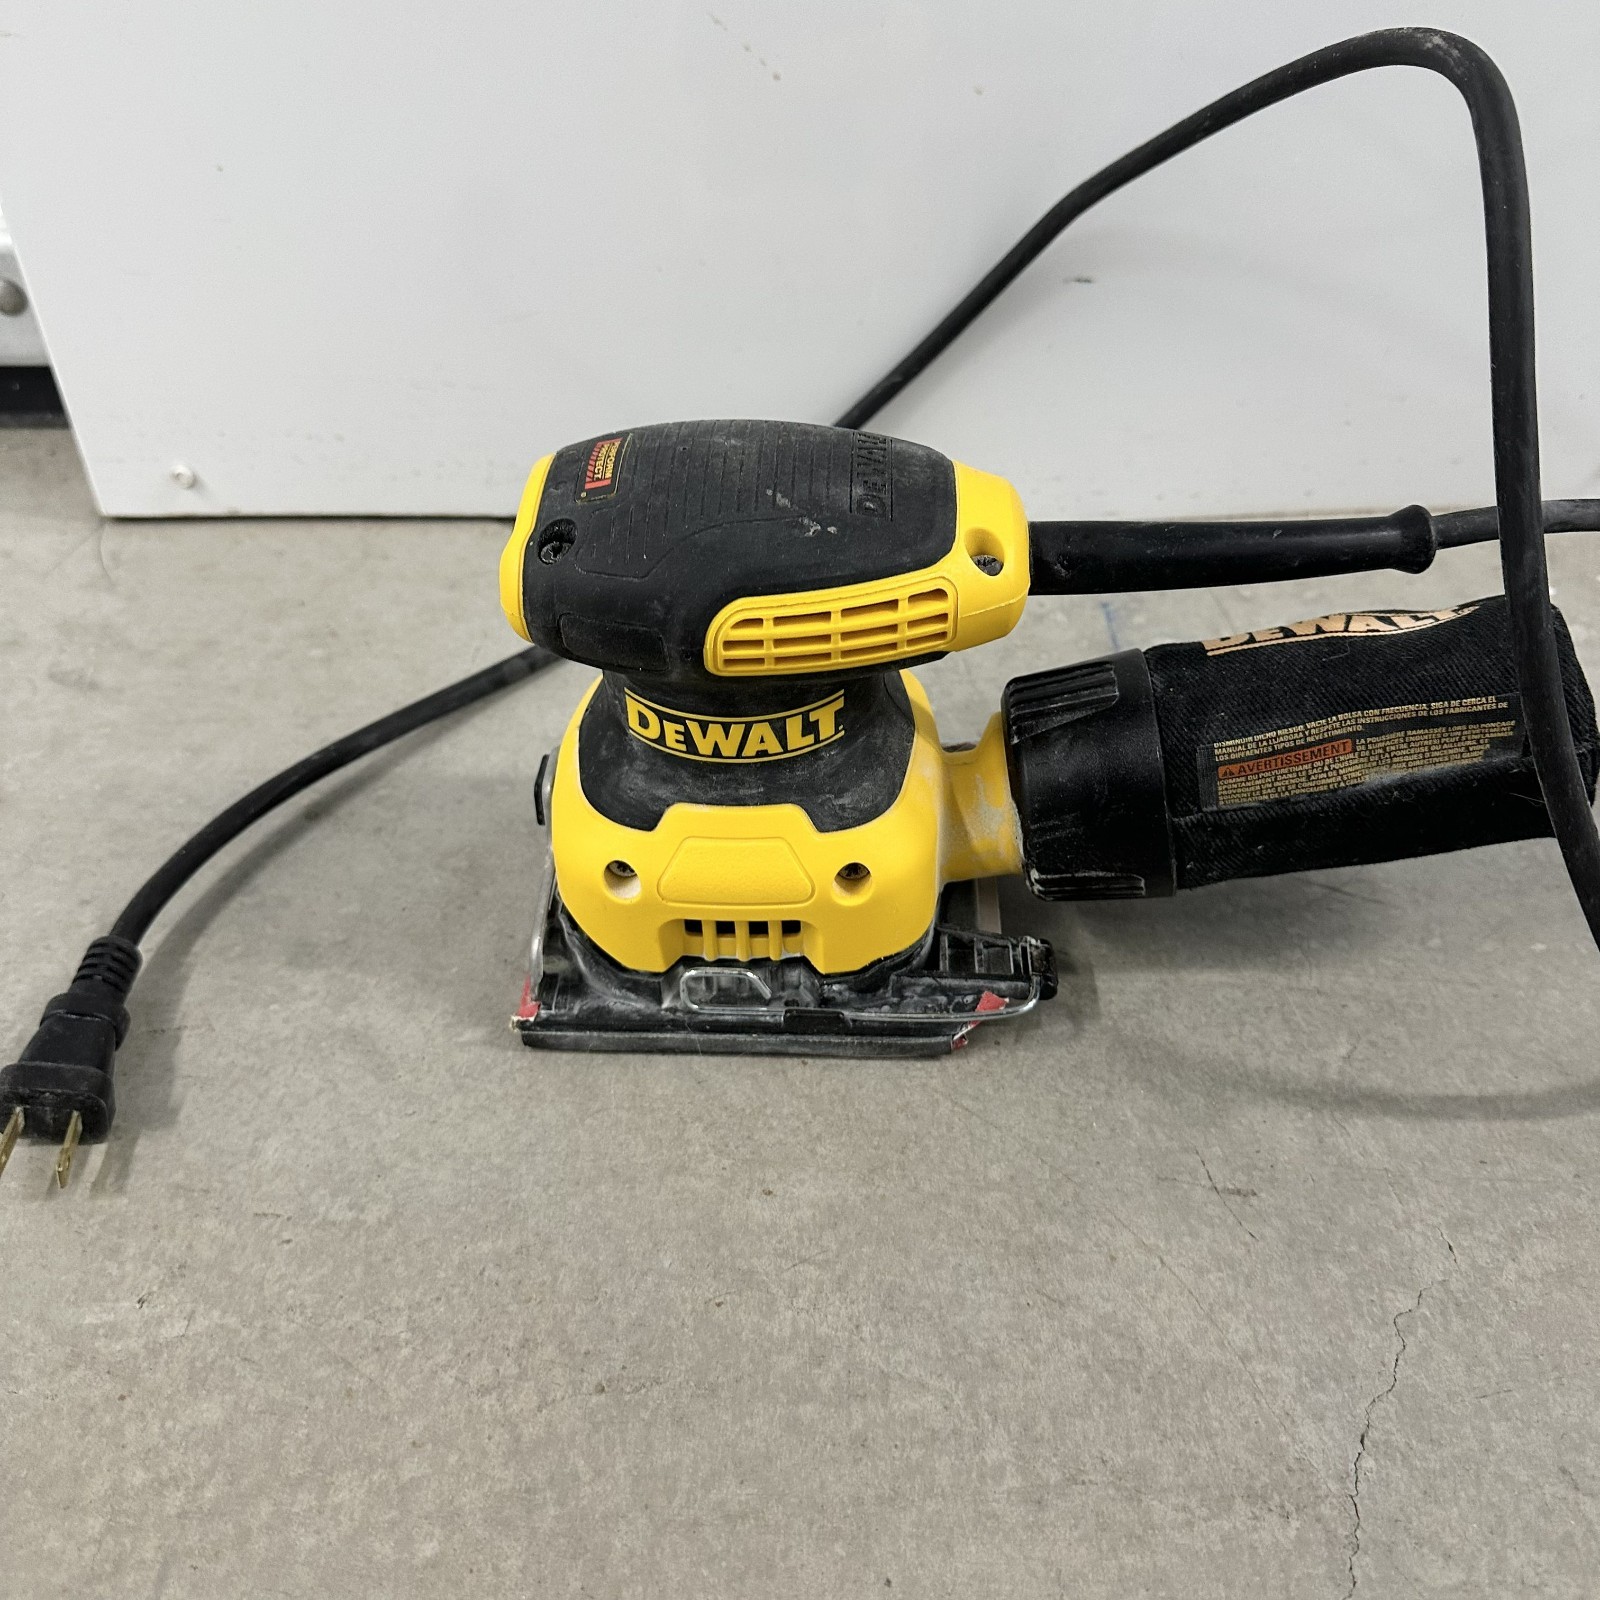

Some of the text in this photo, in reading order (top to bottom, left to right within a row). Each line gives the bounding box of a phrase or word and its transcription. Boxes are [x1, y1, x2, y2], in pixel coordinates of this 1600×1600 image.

[1215, 744, 1246, 755] MANUAL
[1269, 731, 1303, 745] LIJADORA
[1311, 721, 1340, 735] RESPETE
[1342, 718, 1356, 727] LAS
[1358, 711, 1416, 723] INSTRUCCIONES
[1445, 703, 1496, 715] FABRICANTES
[1254, 731, 1276, 741] DICHO
[1338, 711, 1362, 721] BOLSA
[1431, 701, 1449, 709] SIGA
[1462, 697, 1487, 706] CERCA
[1216, 754, 1228, 762] LOS
[1231, 746, 1272, 759] DIFERENTES
[1274, 740, 1294, 751] TIPOS
[1238, 741, 1350, 774] AVERTISSEMENT
[1308, 767, 1322, 776] SAC
[1391, 746, 1429, 758] PONCEUSE
